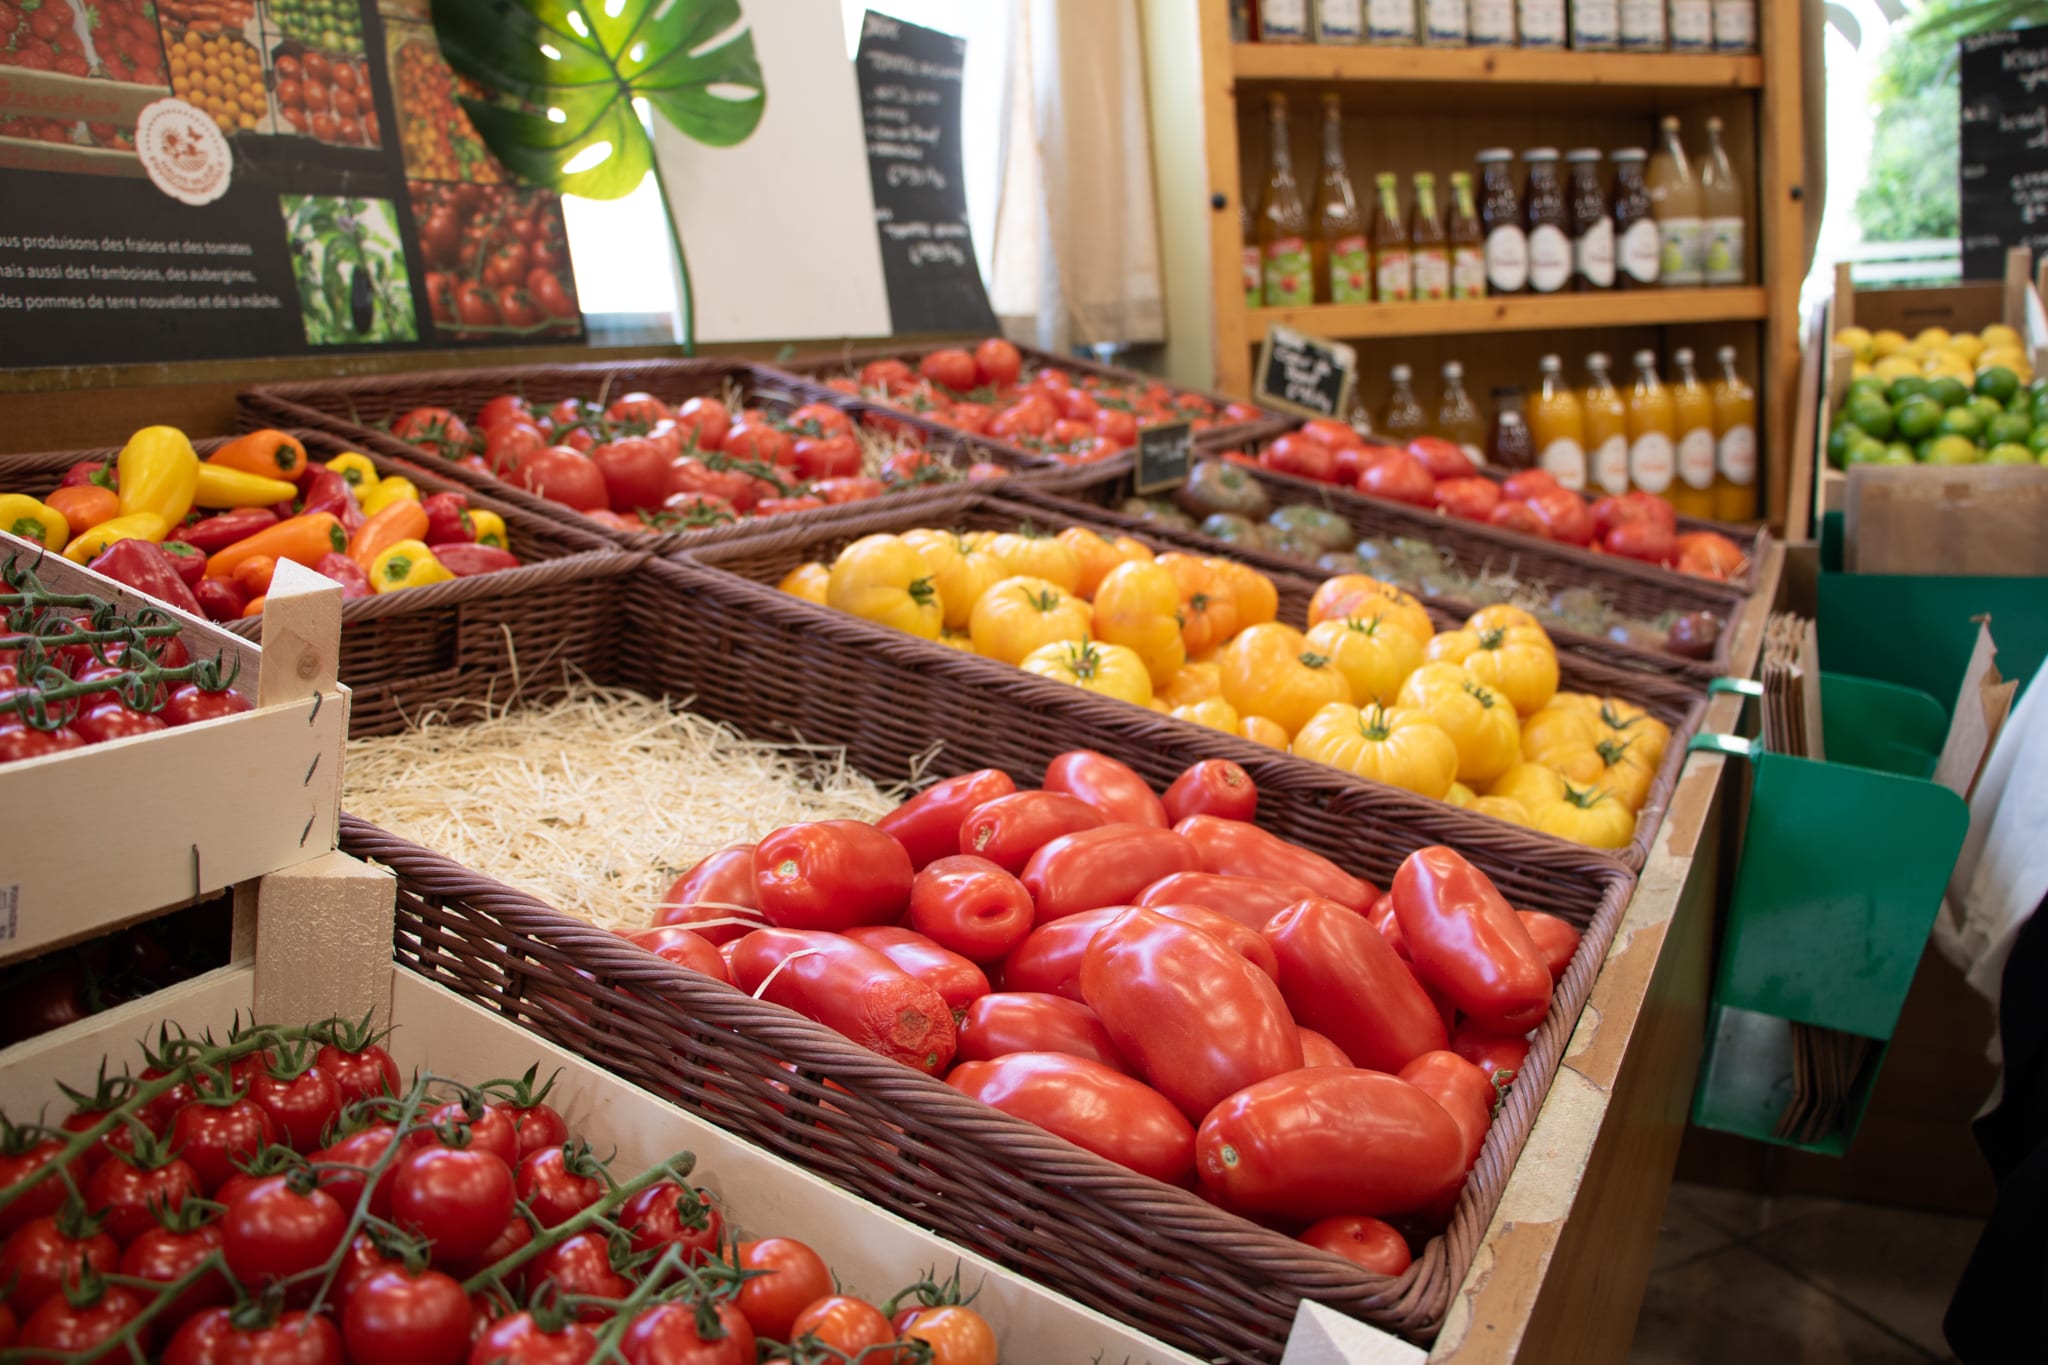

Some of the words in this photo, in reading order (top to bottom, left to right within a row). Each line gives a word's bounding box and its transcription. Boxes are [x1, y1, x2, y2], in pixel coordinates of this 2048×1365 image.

[22, 234, 100, 251] produisons
[101, 235, 125, 252] des
[125, 236, 167, 253] fraises
[168, 240, 182, 254] et
[182, 238, 204, 254] des
[204, 241, 253, 255] tomates
[27, 264, 63, 279] aussi
[65, 264, 90, 280] des
[90, 264, 165, 282] framboises,
[165, 265, 188, 281] des
[189, 267, 257, 285] aubergines,
[25, 296, 85, 311] pommes
[87, 293, 104, 309] de
[106, 295, 137, 309] terre
[139, 294, 197, 309] nouvelles
[198, 295, 211, 309] et
[212, 294, 227, 309] de
[228, 294, 240, 309] la
[240, 293, 283, 309] mâche.
